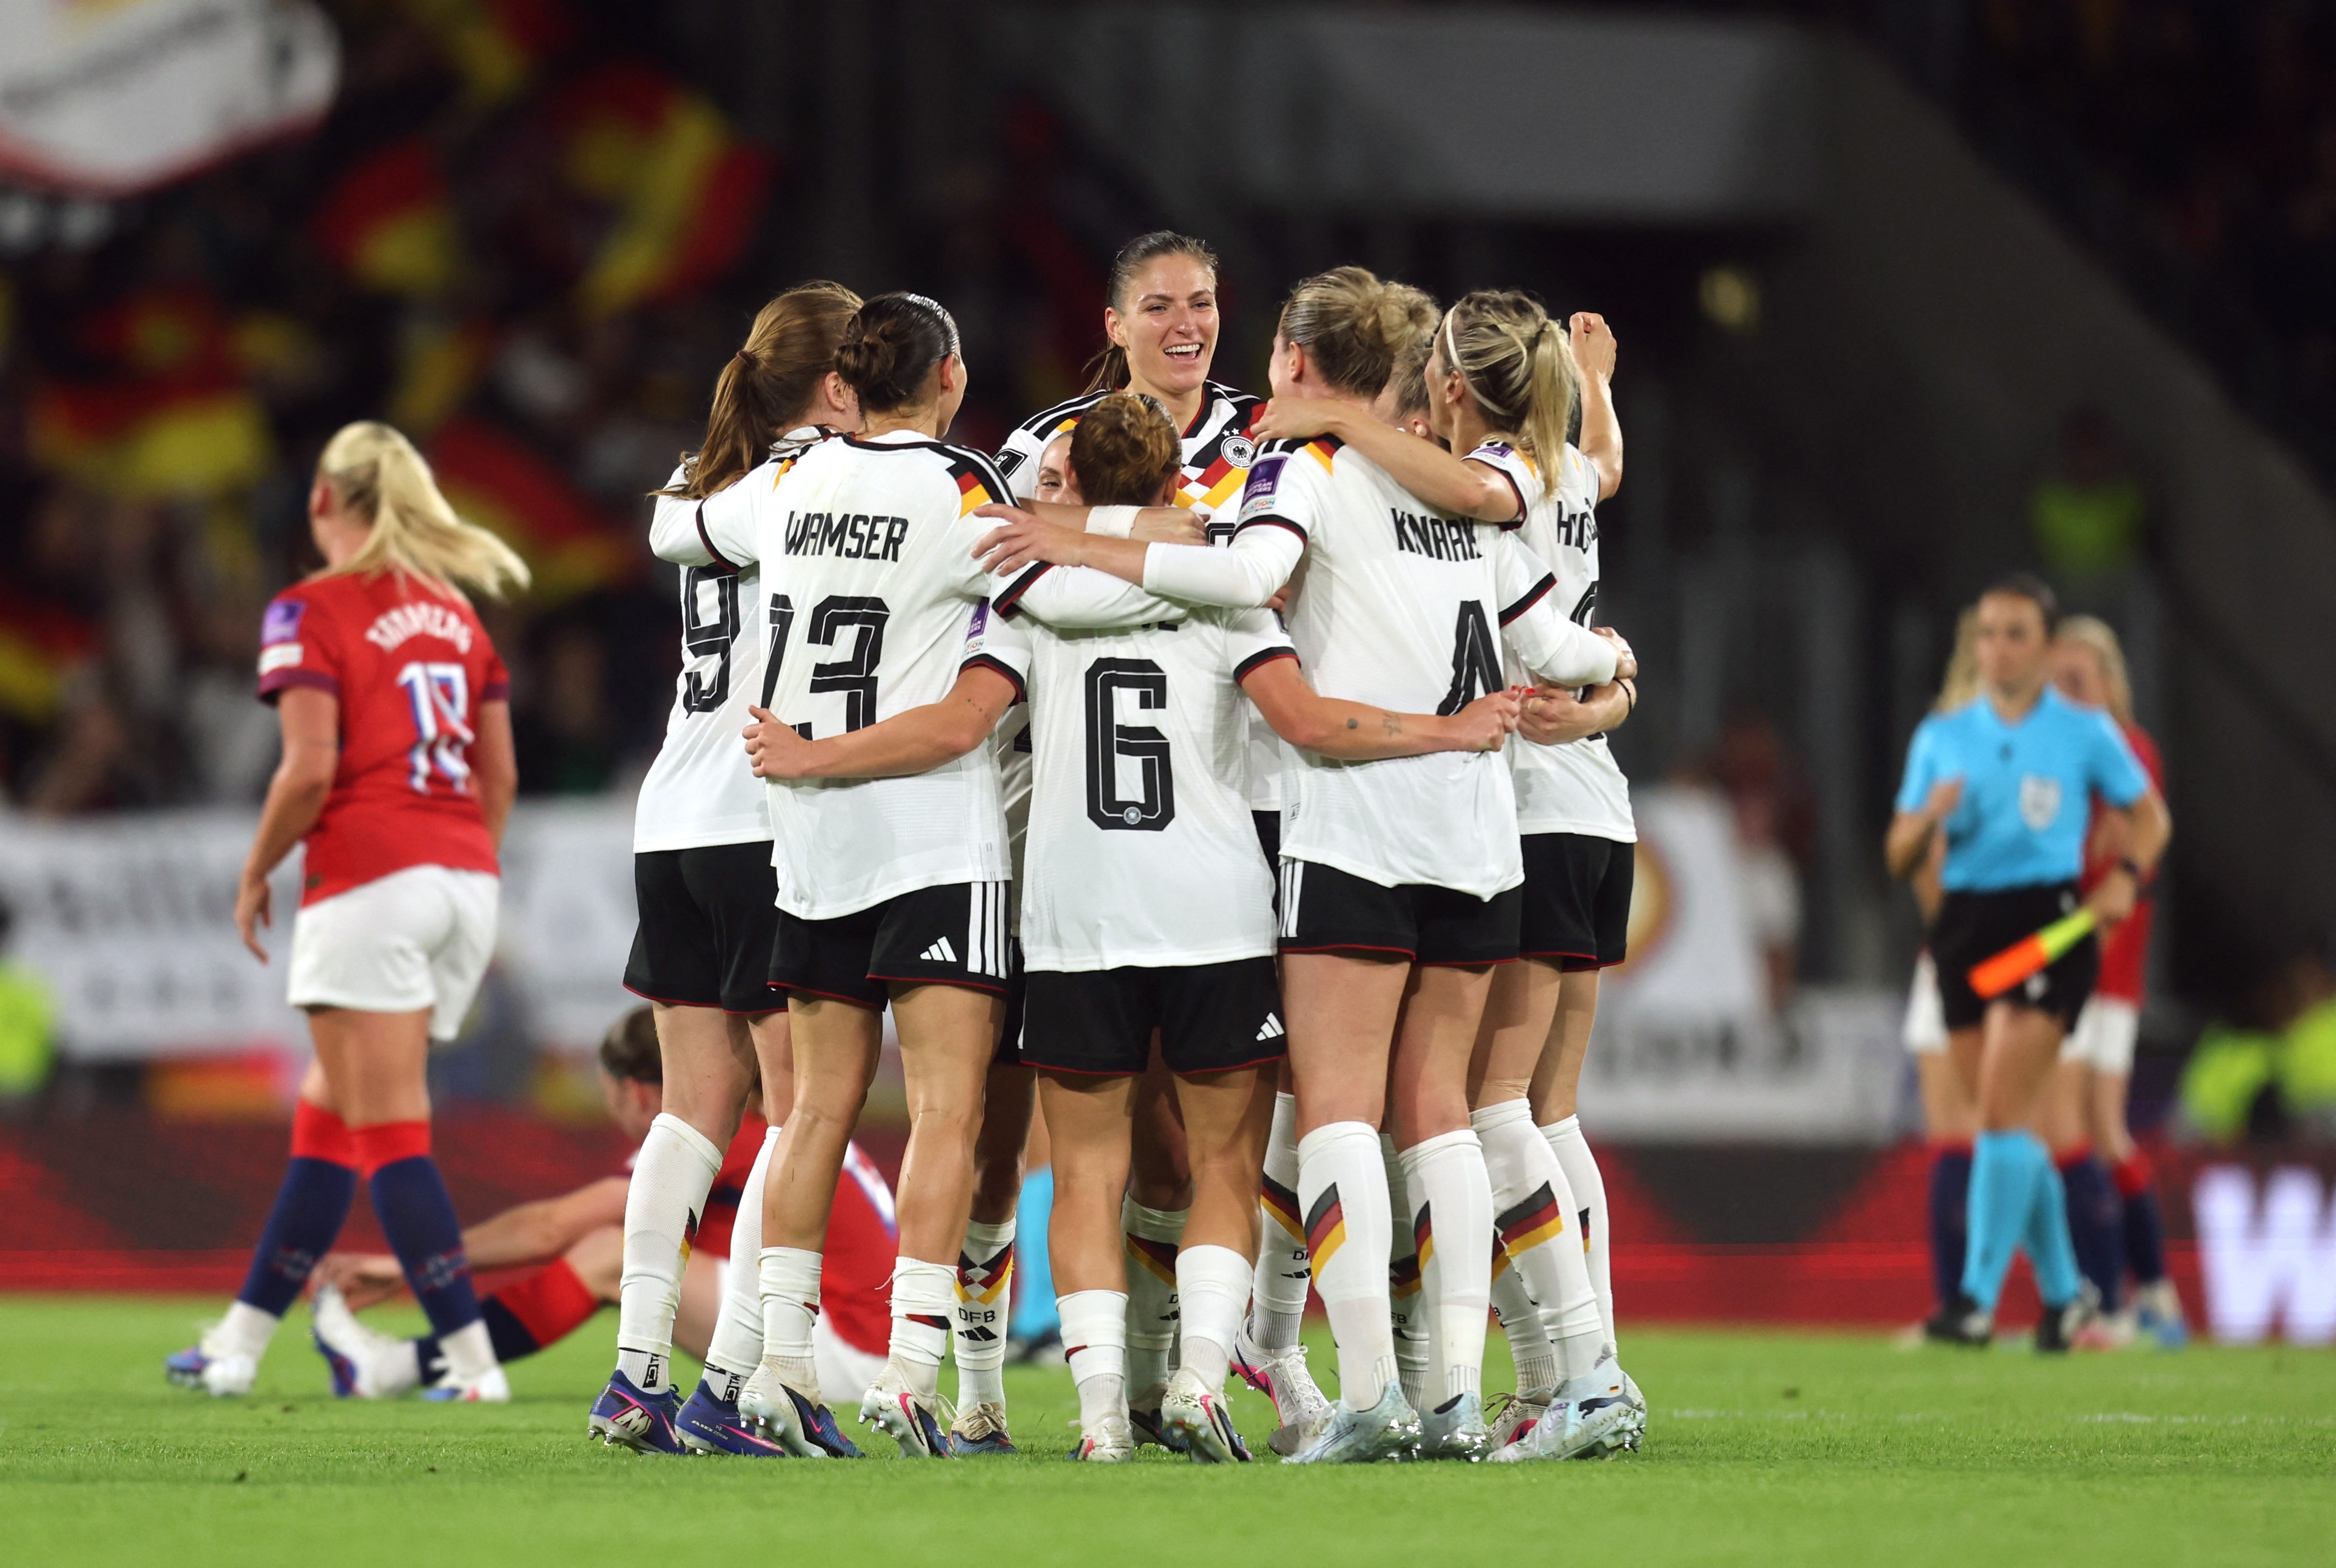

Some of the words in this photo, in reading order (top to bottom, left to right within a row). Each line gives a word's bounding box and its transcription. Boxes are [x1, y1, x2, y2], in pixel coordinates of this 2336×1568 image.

[785, 511, 909, 563] WAMSER
[1391, 508, 1483, 562] KNAAK
[684, 567, 739, 719] 9
[761, 593, 890, 740] 13
[1085, 657, 1175, 831] 6
[958, 1307, 996, 1324] DFB
[712, 1430, 728, 1441] ZOOM
